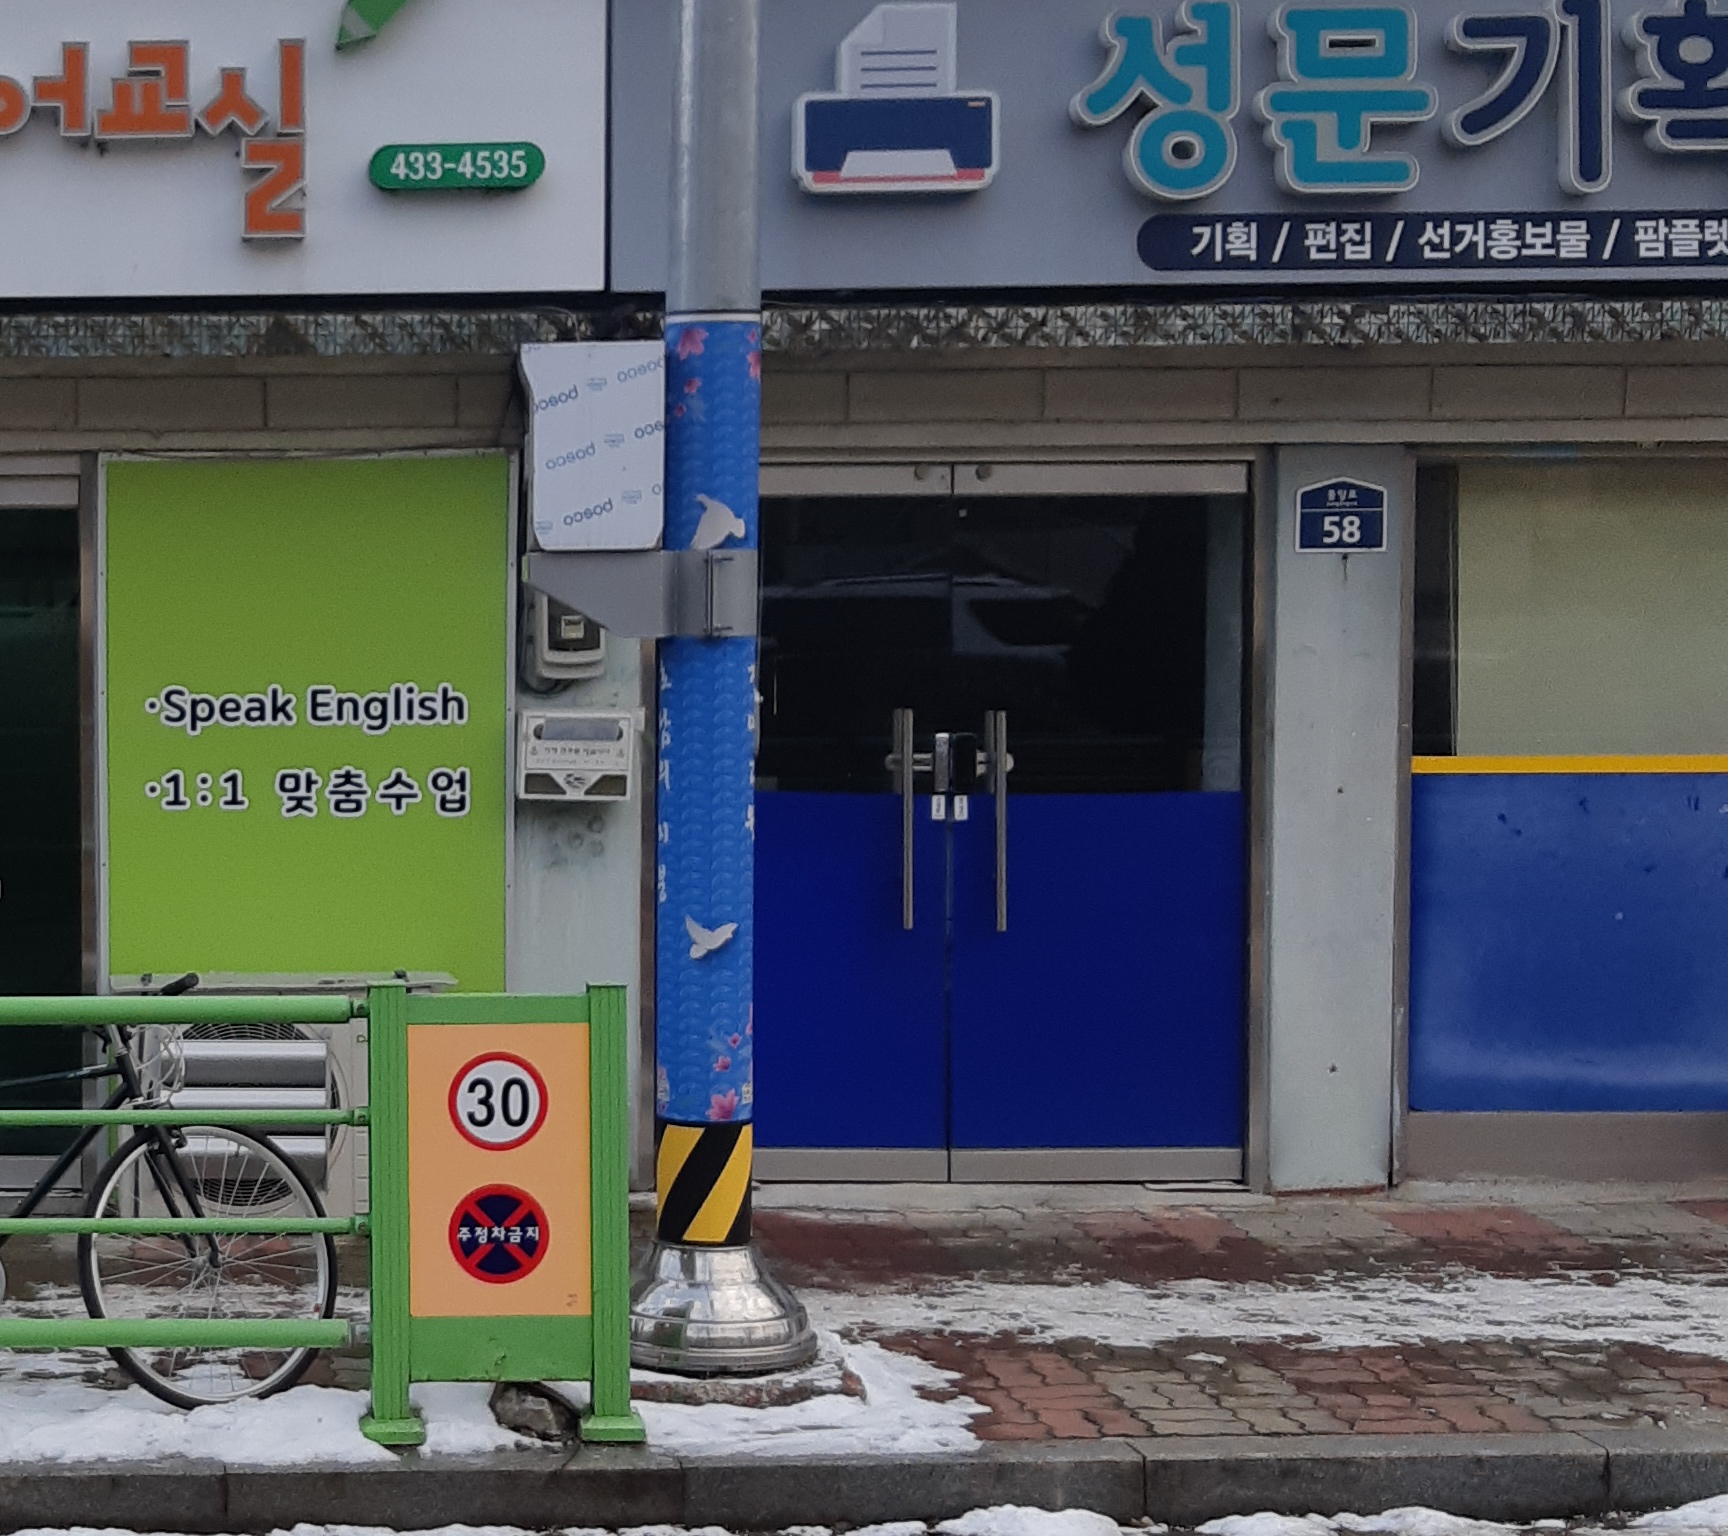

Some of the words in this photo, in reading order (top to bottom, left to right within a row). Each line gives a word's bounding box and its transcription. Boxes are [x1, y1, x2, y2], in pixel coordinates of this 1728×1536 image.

[389, 149, 528, 181] 433-4535
[1191, 220, 1259, 263] 기획
[1304, 221, 1373, 261] 편집
[1418, 218, 1592, 261] 선거홍보물
[1322, 515, 1361, 544] 58
[307, 682, 469, 736] English
[275, 766, 471, 818] 맞춤수업
[466, 1077, 530, 1128] 30
[456, 1225, 540, 1245] 주정차금지
